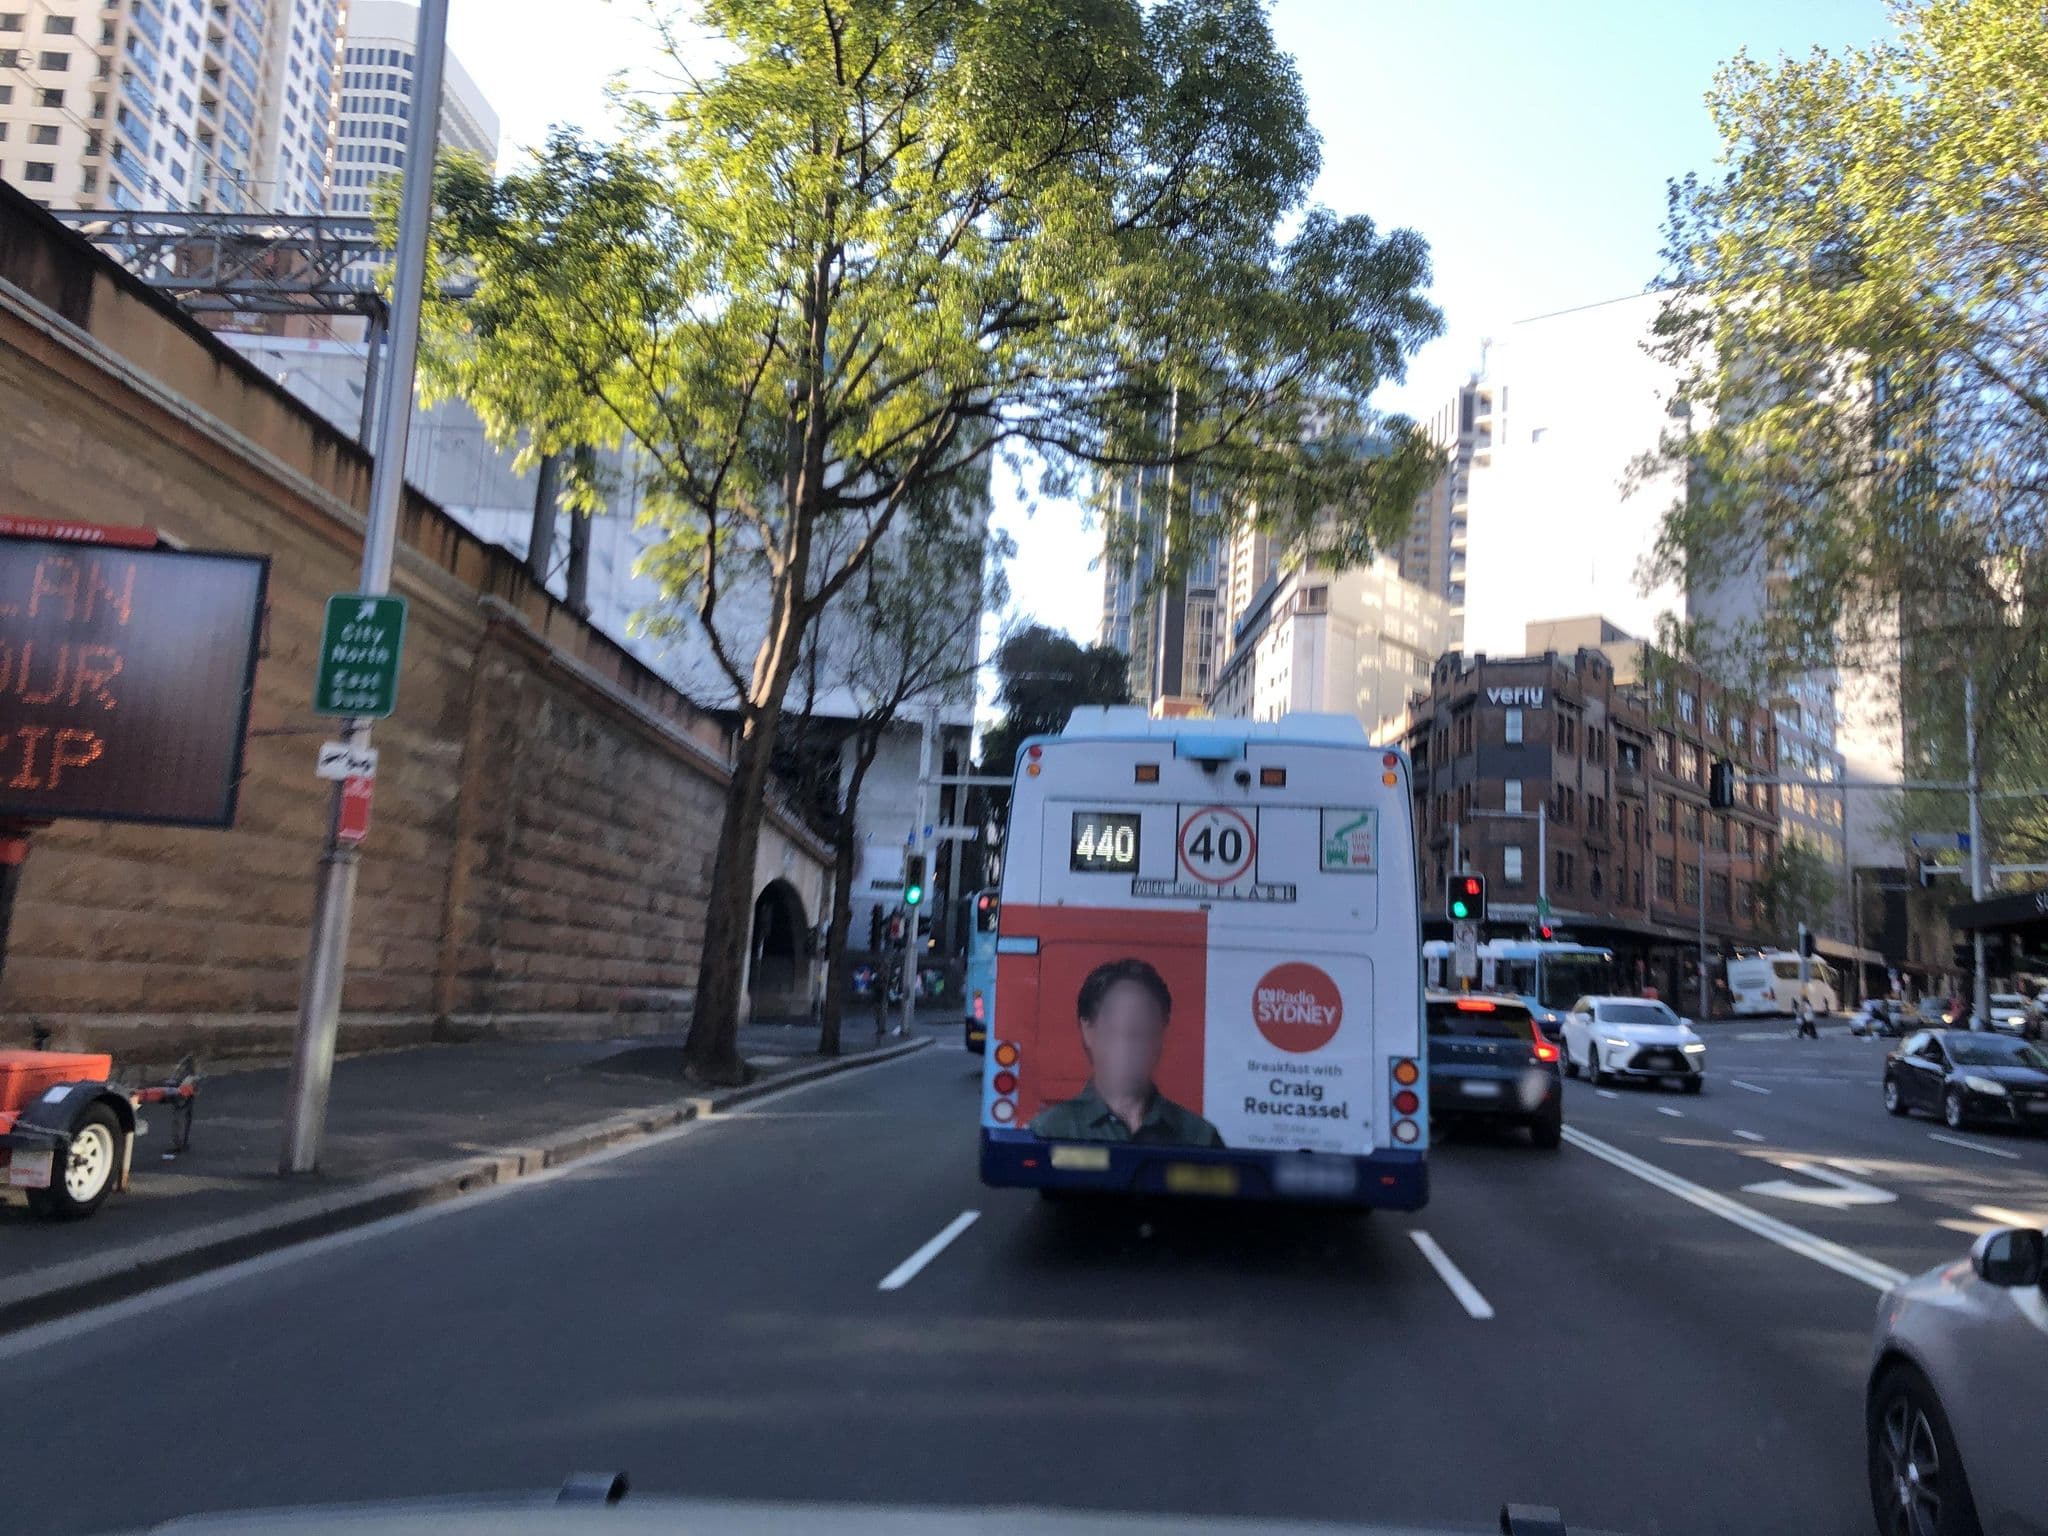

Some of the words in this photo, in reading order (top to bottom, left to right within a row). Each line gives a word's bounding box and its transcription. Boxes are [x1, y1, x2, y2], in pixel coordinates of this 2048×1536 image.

[0, 556, 137, 625] AN
[341, 623, 385, 647] City
[331, 645, 389, 664] North
[0, 727, 104, 790] IP
[1076, 825, 1135, 862] 440
[1189, 827, 1242, 864] 40
[1276, 988, 1316, 1004] Radio
[1258, 1002, 1337, 1025] SYDNEY
[1248, 1061, 1309, 1074] Breakfast
[1313, 1064, 1343, 1077] with
[1269, 1078, 1324, 1101] Craig
[1244, 1096, 1349, 1120] Reucassel
